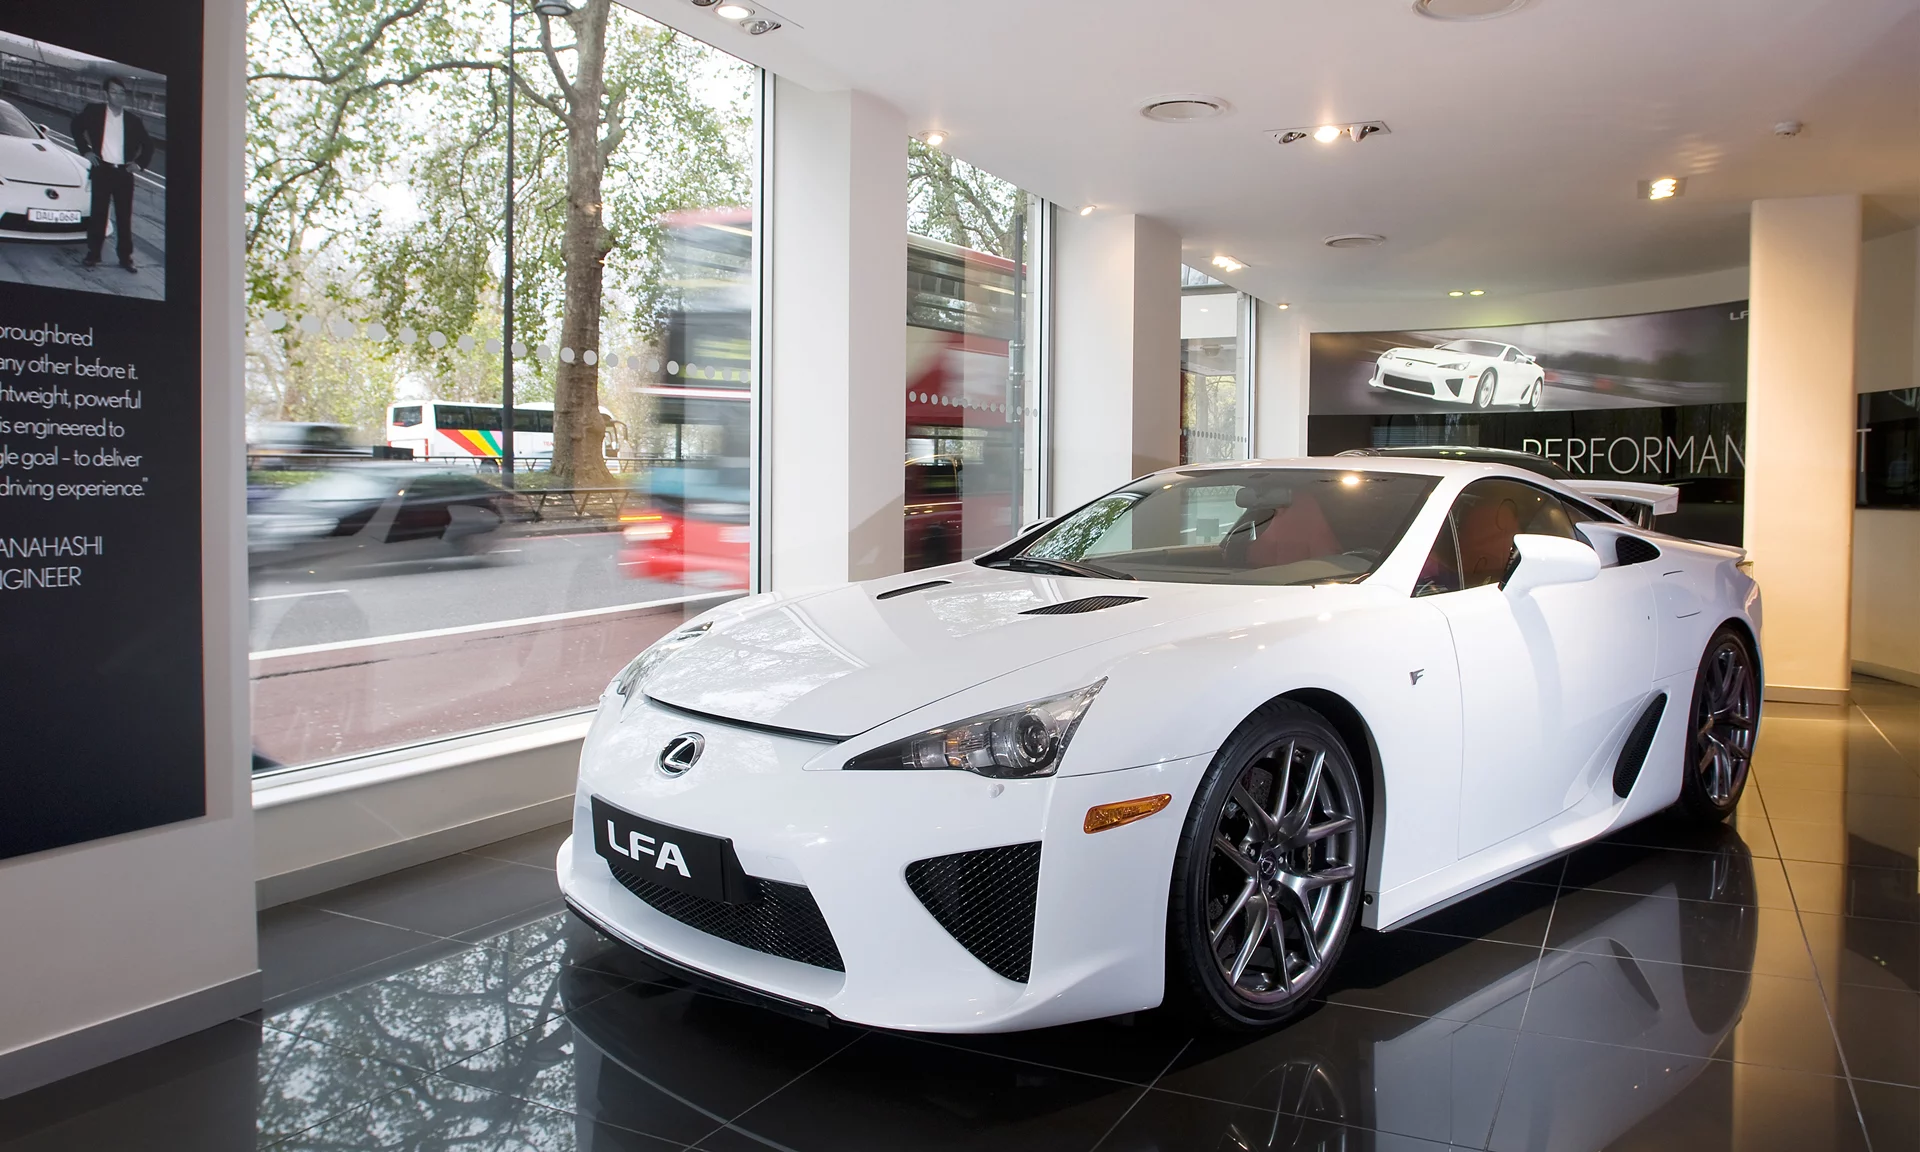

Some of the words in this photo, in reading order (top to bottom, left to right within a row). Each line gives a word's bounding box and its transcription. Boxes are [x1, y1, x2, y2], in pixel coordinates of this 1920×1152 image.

[28, 353, 72, 376] other
[75, 356, 126, 380] before
[128, 363, 139, 380] it.
[74, 389, 142, 410] powerful
[0, 416, 11, 434] is
[14, 418, 106, 439] engineered
[109, 423, 125, 438] to
[21, 446, 58, 470] goal
[74, 449, 91, 467] to
[92, 447, 143, 468] deliver
[0, 476, 54, 500] driving
[0, 536, 103, 558] ANAHASHI
[0, 567, 82, 590] GINEER
[607, 819, 692, 879] LFA
